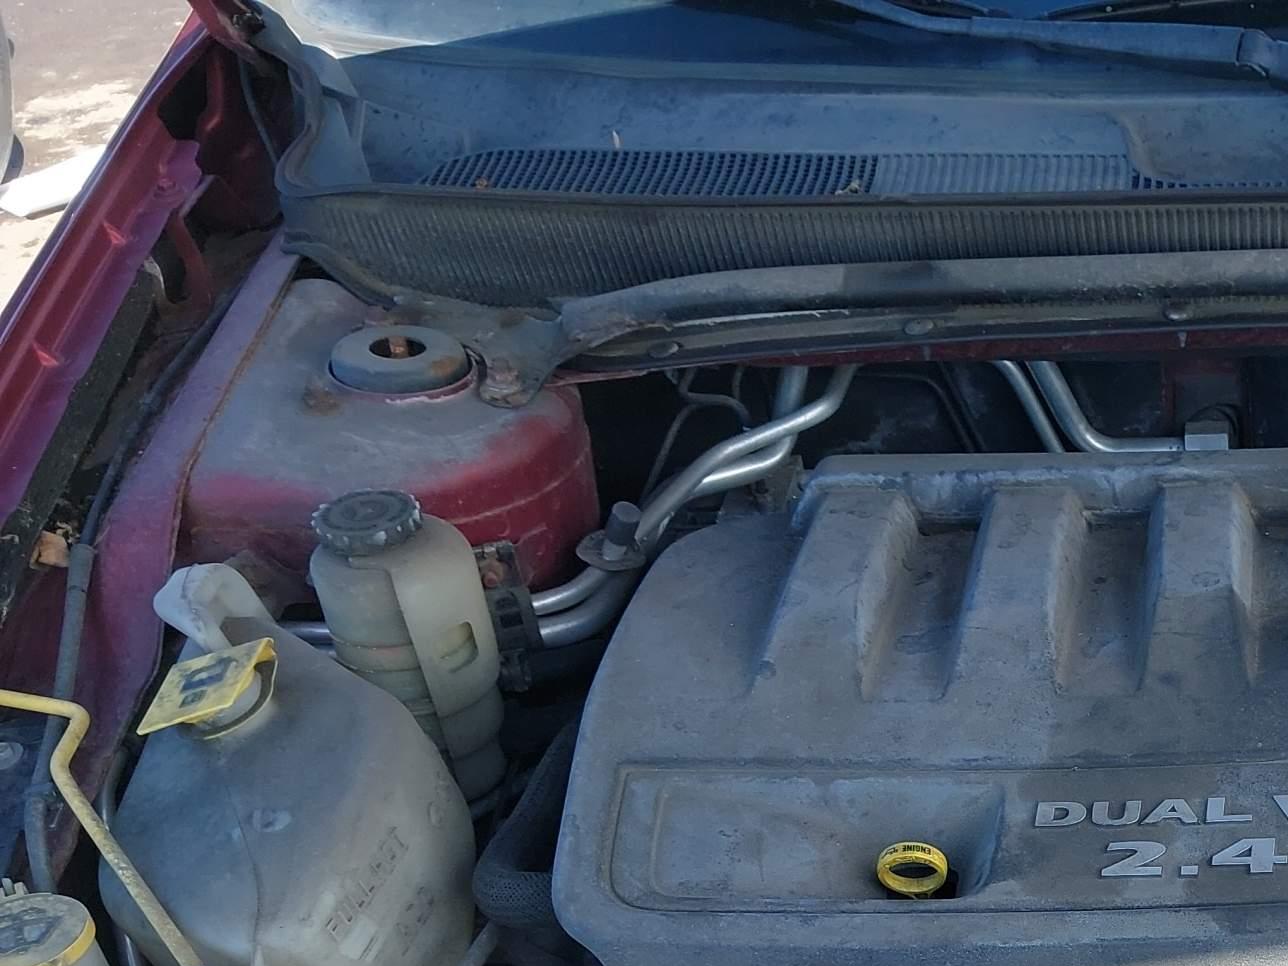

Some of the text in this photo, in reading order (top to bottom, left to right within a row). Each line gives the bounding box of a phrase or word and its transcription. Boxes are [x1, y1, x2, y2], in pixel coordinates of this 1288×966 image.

[1034, 796, 1253, 828] DUAL
[902, 844, 932, 856] ENGINE
[1100, 837, 1288, 878] 2.4
[325, 879, 376, 942] FULL
